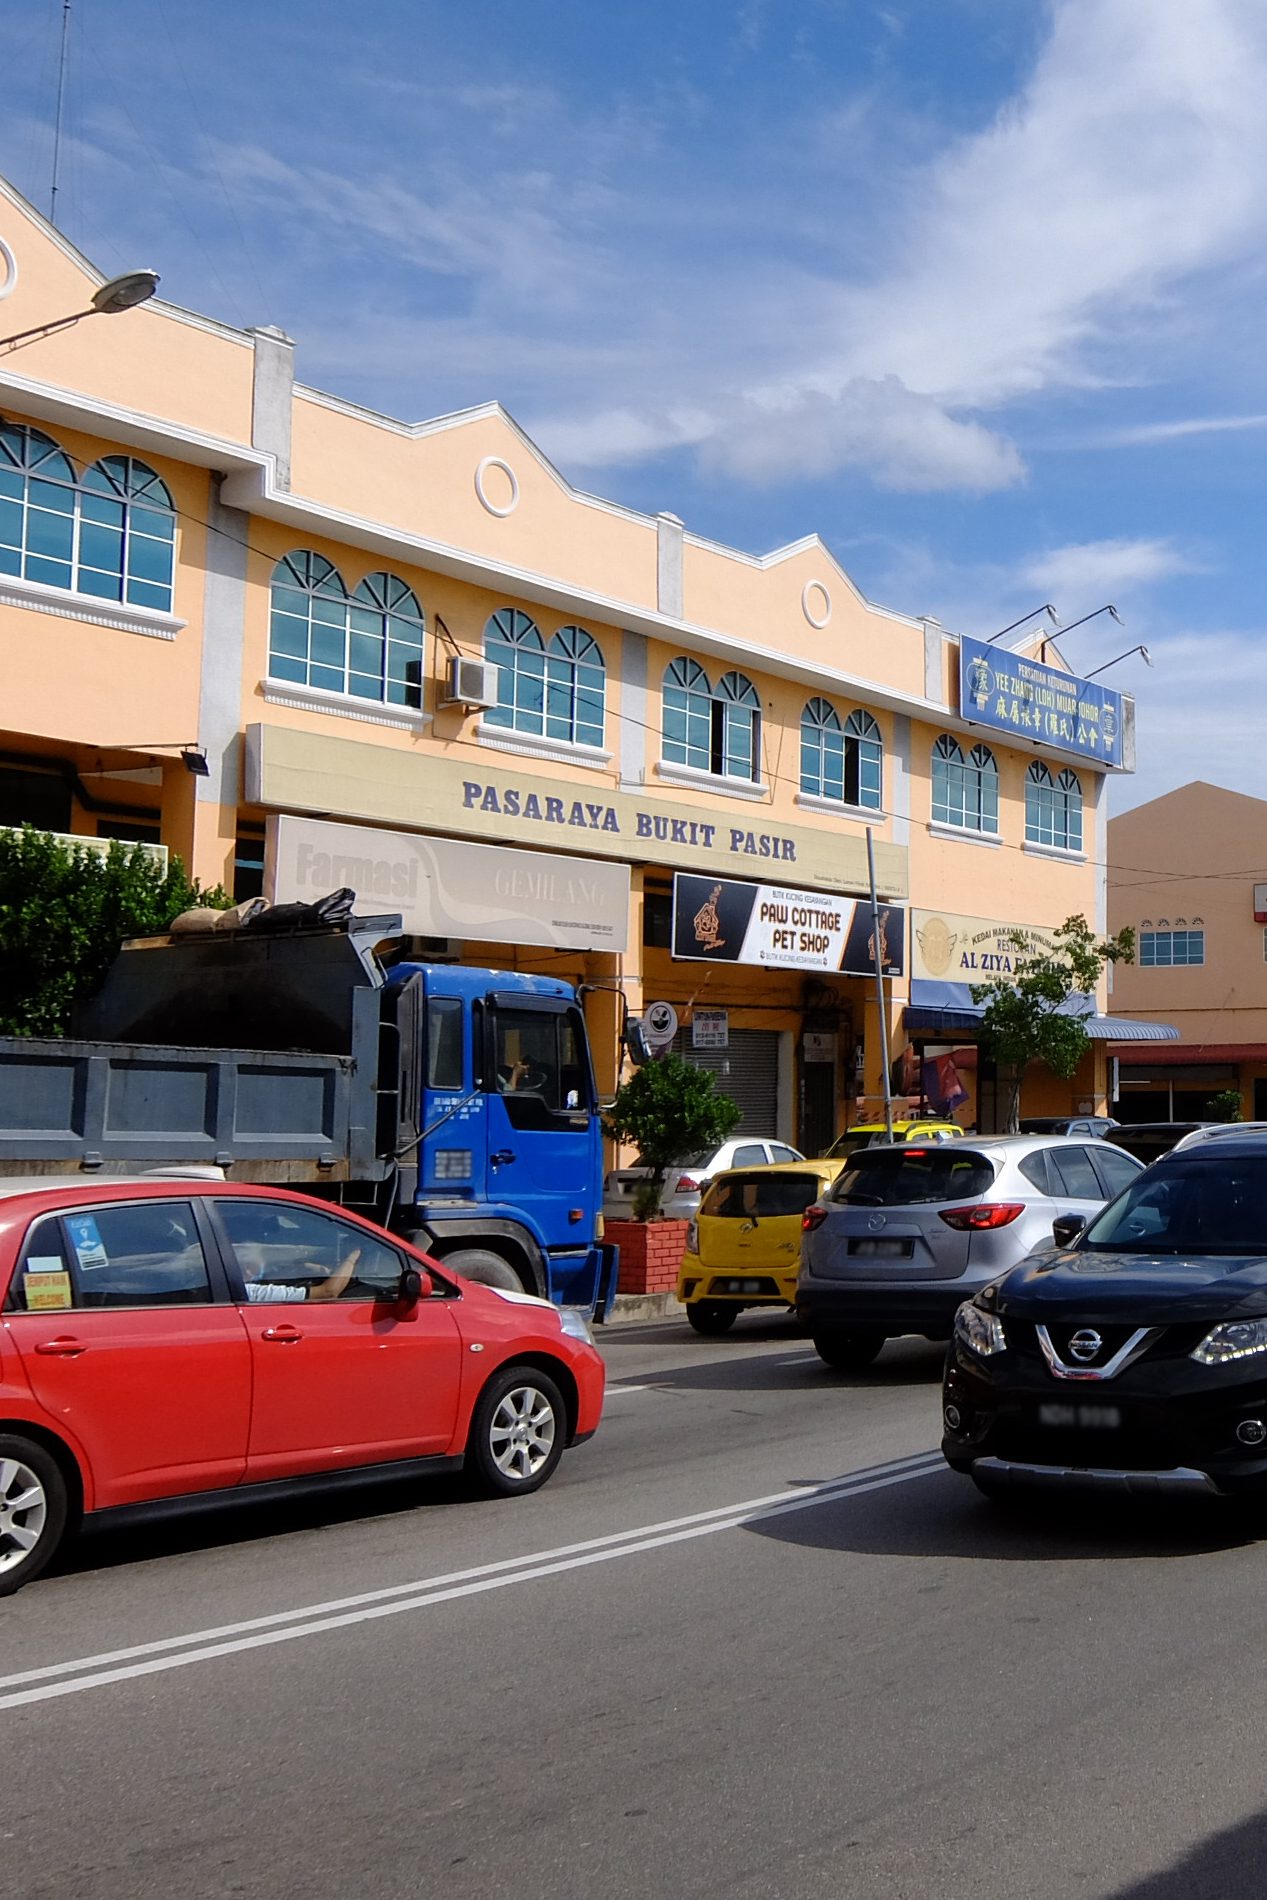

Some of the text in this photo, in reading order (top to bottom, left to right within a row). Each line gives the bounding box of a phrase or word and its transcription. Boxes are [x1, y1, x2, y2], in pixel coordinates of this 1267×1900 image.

[995, 671, 1099, 723] YEE ZHANG (LOH) MUAR JOHOR
[462, 781, 797, 862] PASARAYA BUKIT PASIR
[296, 842, 419, 899] Farmasi
[494, 866, 606, 906] GEMILANG
[785, 892, 804, 902] KUCING
[760, 902, 842, 932] PAW COTTAGE
[772, 929, 830, 954] PET SHOP
[971, 930, 991, 946] KEDAI
[992, 927, 1024, 940] MAKANAN
[997, 938, 1036, 955] RESTOAN
[960, 951, 978, 969] AL
[981, 953, 1012, 973] ZIYA
